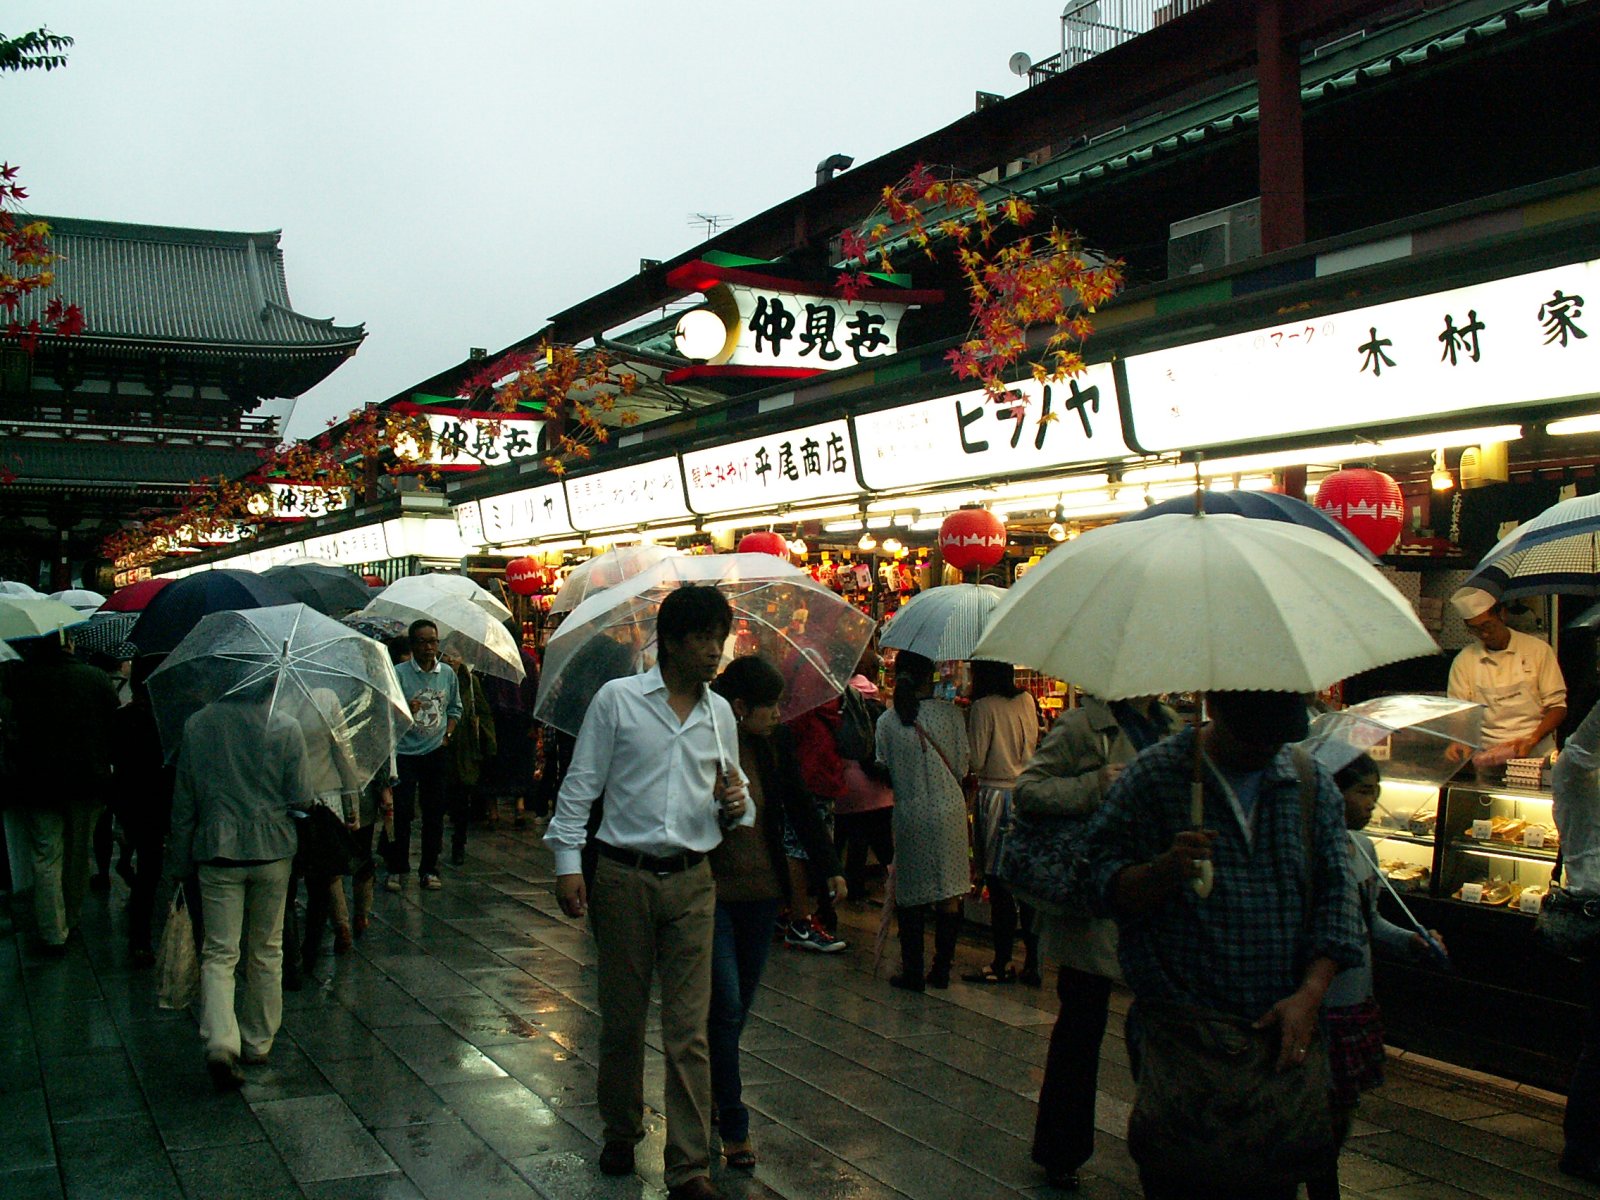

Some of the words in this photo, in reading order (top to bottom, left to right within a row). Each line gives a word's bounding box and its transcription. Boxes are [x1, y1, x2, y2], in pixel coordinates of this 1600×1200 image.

[749, 295, 890, 363] 仲見世
[1358, 289, 1589, 377] 木村家
[438, 421, 532, 461] 仲見世
[956, 379, 1100, 454] ヒラノヤ
[755, 431, 847, 488] 平尾商店
